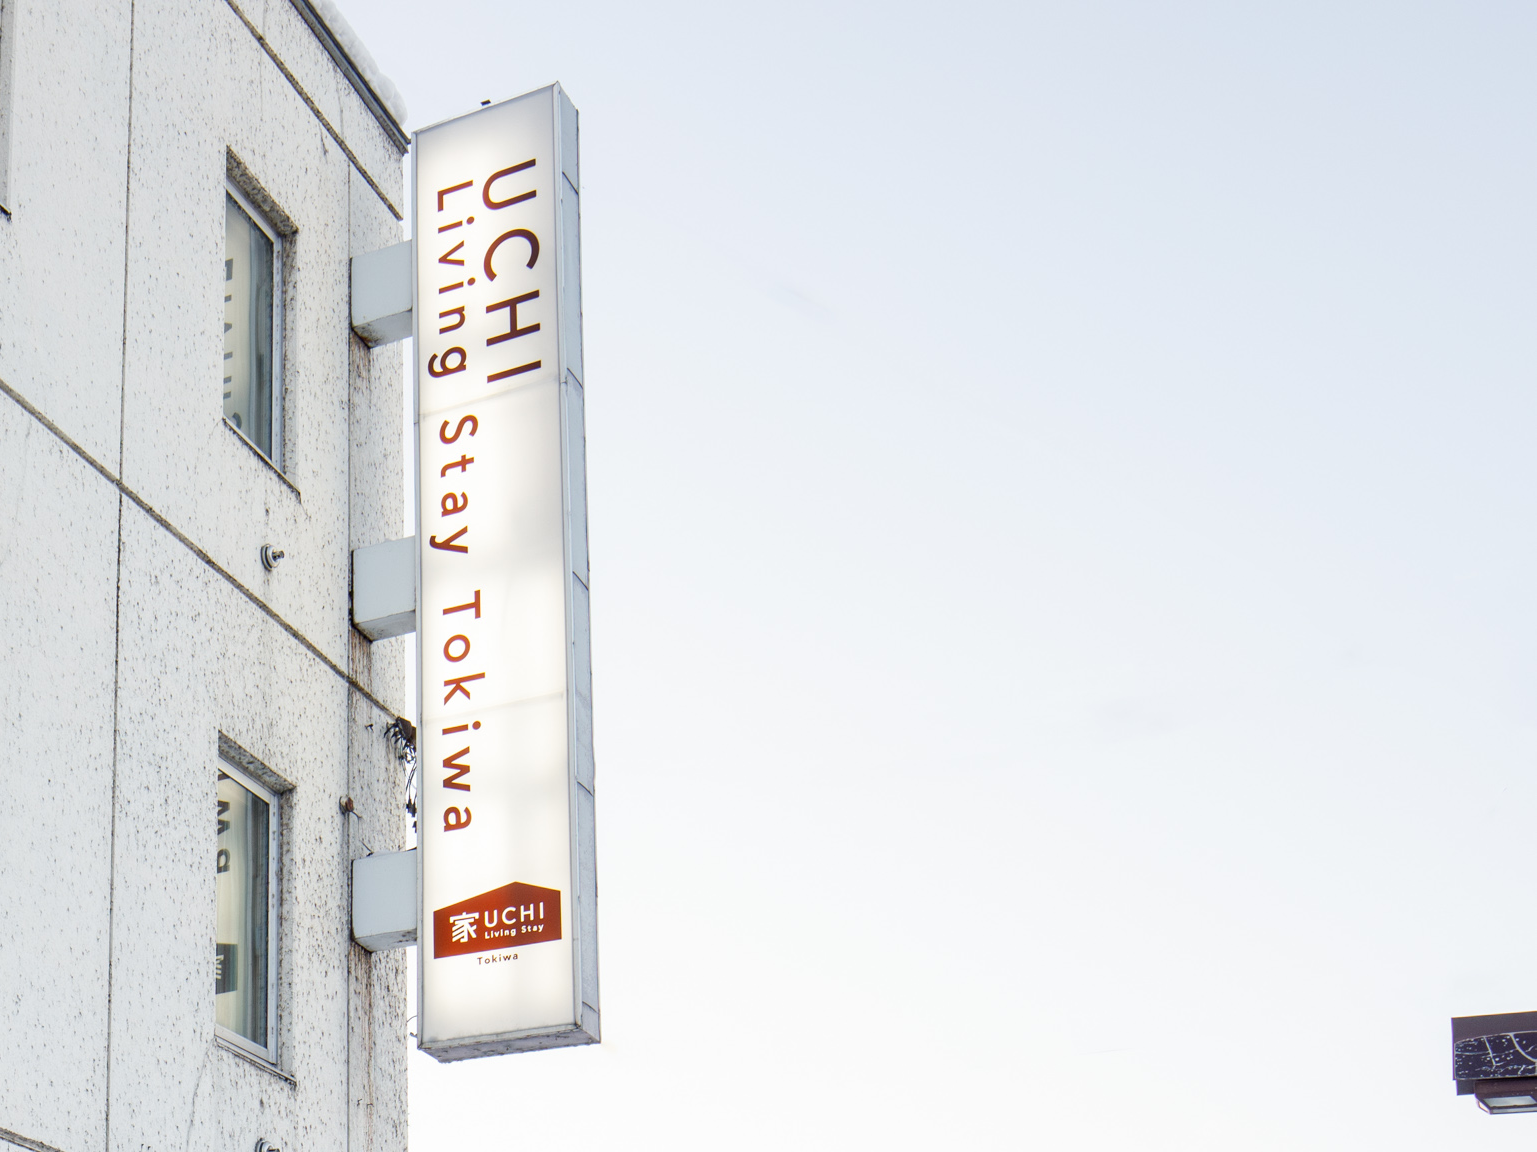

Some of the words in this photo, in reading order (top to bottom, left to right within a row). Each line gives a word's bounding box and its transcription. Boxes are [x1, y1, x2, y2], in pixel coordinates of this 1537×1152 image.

[428, 180, 475, 378] Living
[482, 158, 542, 384] UCHI
[429, 414, 479, 554] Stay
[442, 589, 486, 832] Tokiwa
[449, 911, 479, 943] 家
[484, 901, 544, 928] UCHI
[484, 928, 516, 939] Living
[521, 923, 544, 934] Stay
[477, 953, 519, 965] Tokiwa
